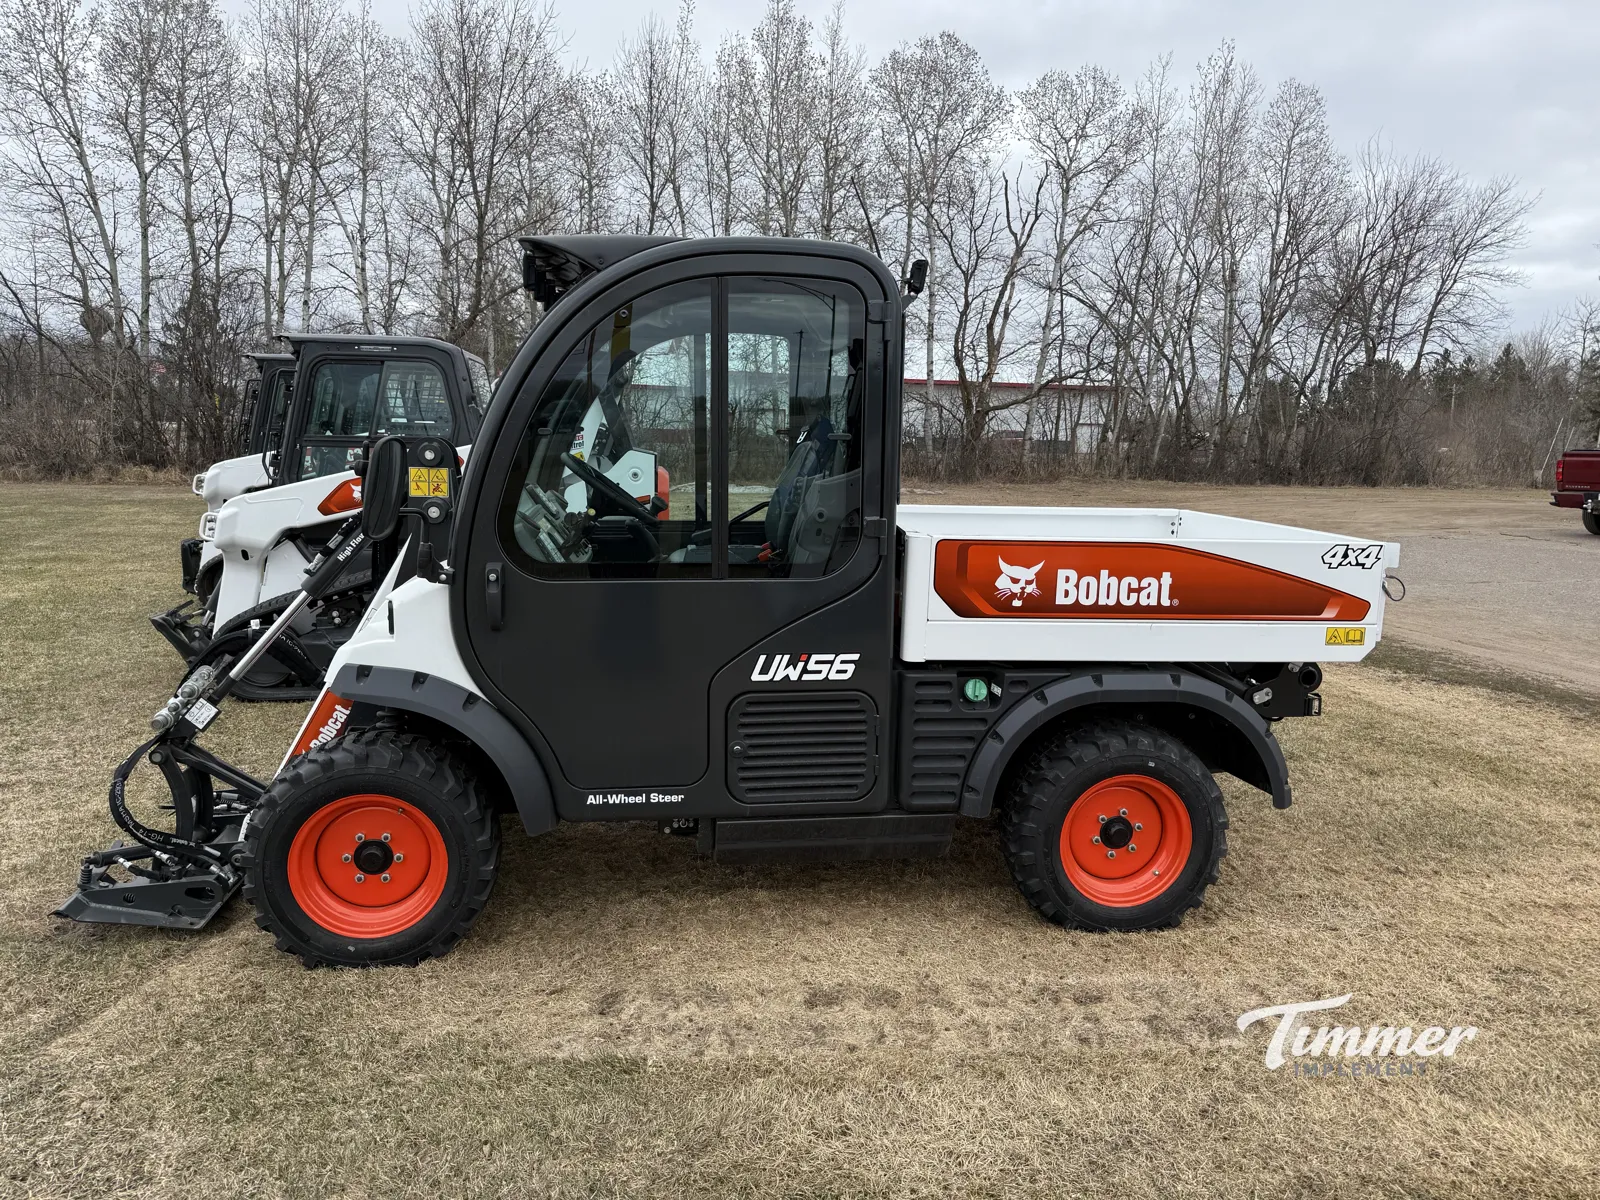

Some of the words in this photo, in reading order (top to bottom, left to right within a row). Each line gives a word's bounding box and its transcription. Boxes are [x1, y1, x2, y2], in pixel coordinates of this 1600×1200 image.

[336, 546, 354, 562] High
[1320, 543, 1384, 570] 4x4
[750, 653, 861, 682] UW56
[586, 792, 646, 805] All-Wheel
[649, 792, 685, 804] Steer
